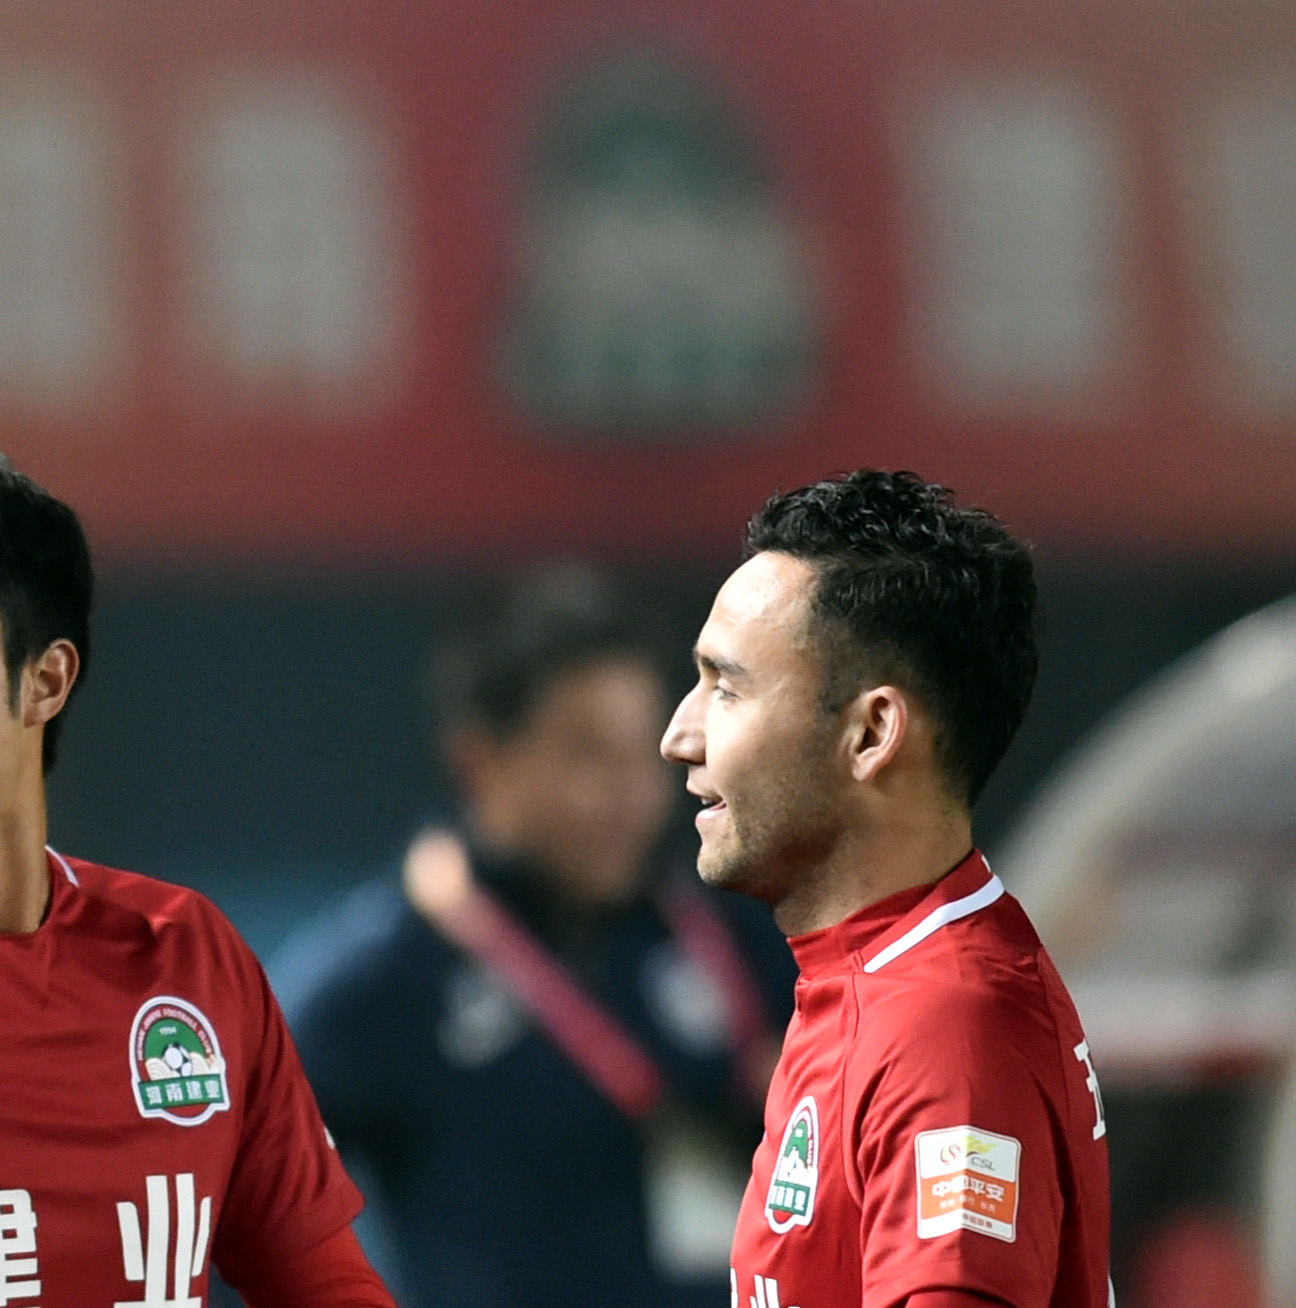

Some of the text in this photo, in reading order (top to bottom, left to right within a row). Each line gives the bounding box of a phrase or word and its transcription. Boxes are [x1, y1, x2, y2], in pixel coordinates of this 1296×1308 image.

[970, 1155, 996, 1171] CSL
[931, 1174, 1005, 1202] 中平安
